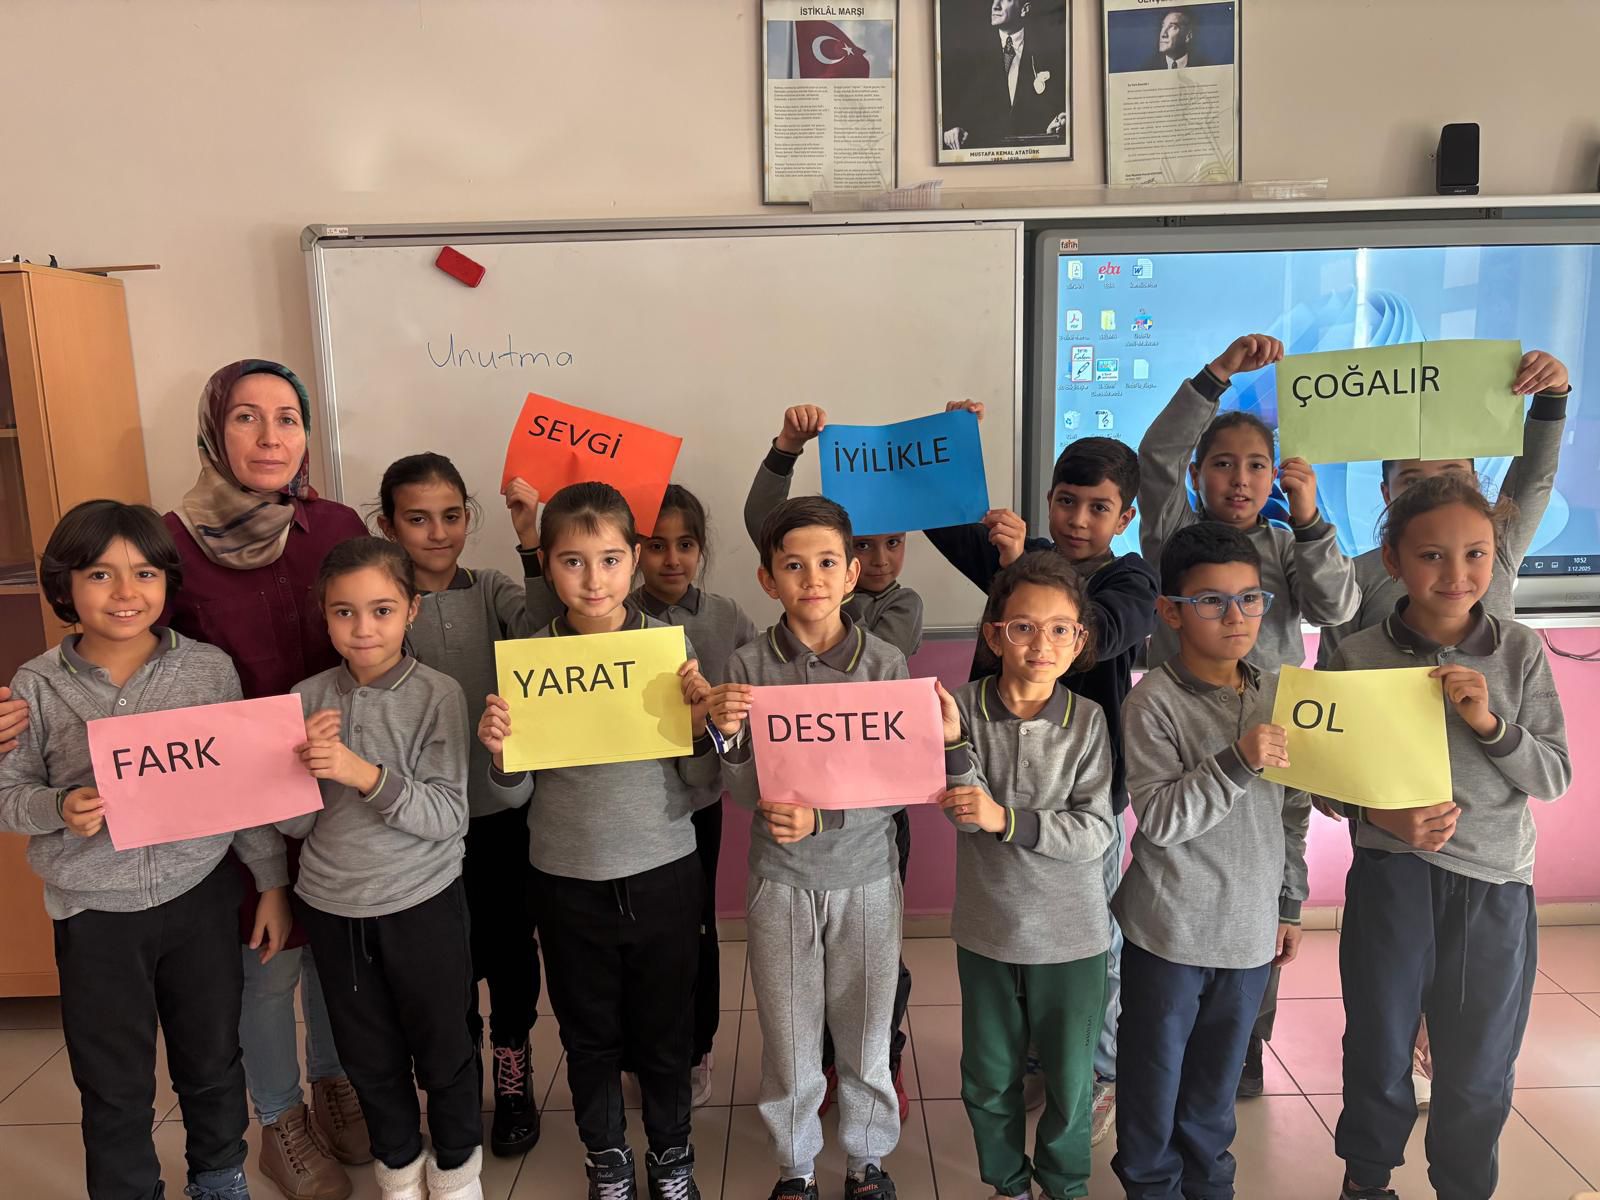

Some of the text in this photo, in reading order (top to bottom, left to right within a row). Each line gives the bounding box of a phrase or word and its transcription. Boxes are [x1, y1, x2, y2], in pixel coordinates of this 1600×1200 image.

[800, 5, 865, 17] İSTİKLÂL MARŞI
[969, 150, 995, 158] MUSTAFA
[1014, 148, 1040, 156] ATATÜRK
[1098, 261, 1121, 275] eba
[427, 333, 574, 369] Unutma
[1292, 364, 1440, 408] ÇOĞALIR
[528, 414, 622, 459] SEVGİ
[834, 436, 951, 474] İYİLİKLE
[513, 660, 636, 698] YARAT
[767, 710, 906, 743] DESTEK
[1292, 699, 1344, 733] OL
[112, 736, 221, 780] FARK
